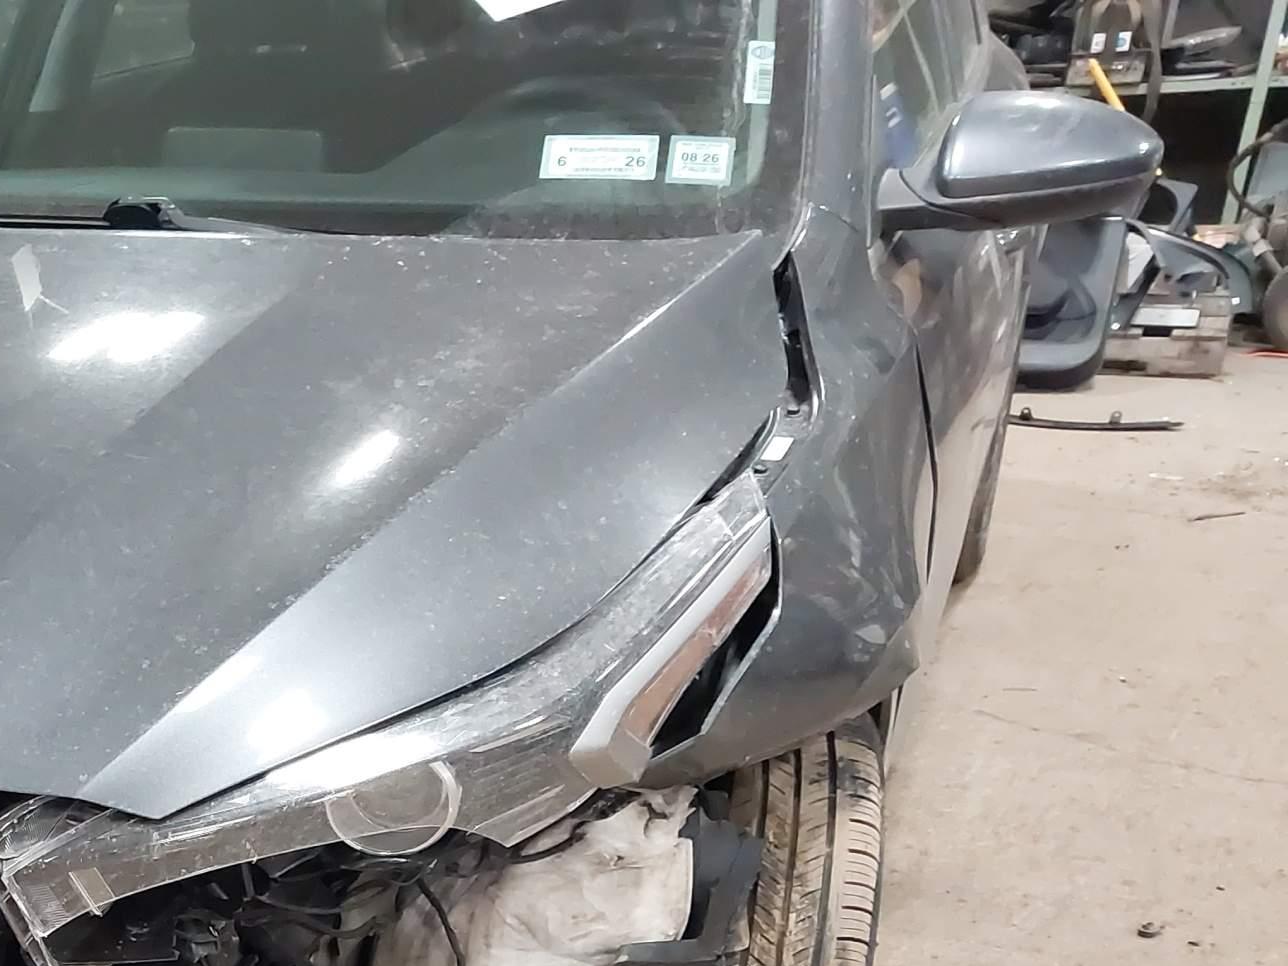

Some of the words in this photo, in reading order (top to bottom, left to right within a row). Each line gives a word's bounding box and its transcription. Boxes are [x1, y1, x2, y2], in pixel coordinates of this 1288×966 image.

[557, 156, 568, 167] 6
[624, 156, 647, 167] 26
[681, 152, 698, 162] 08
[702, 153, 720, 163] 26
